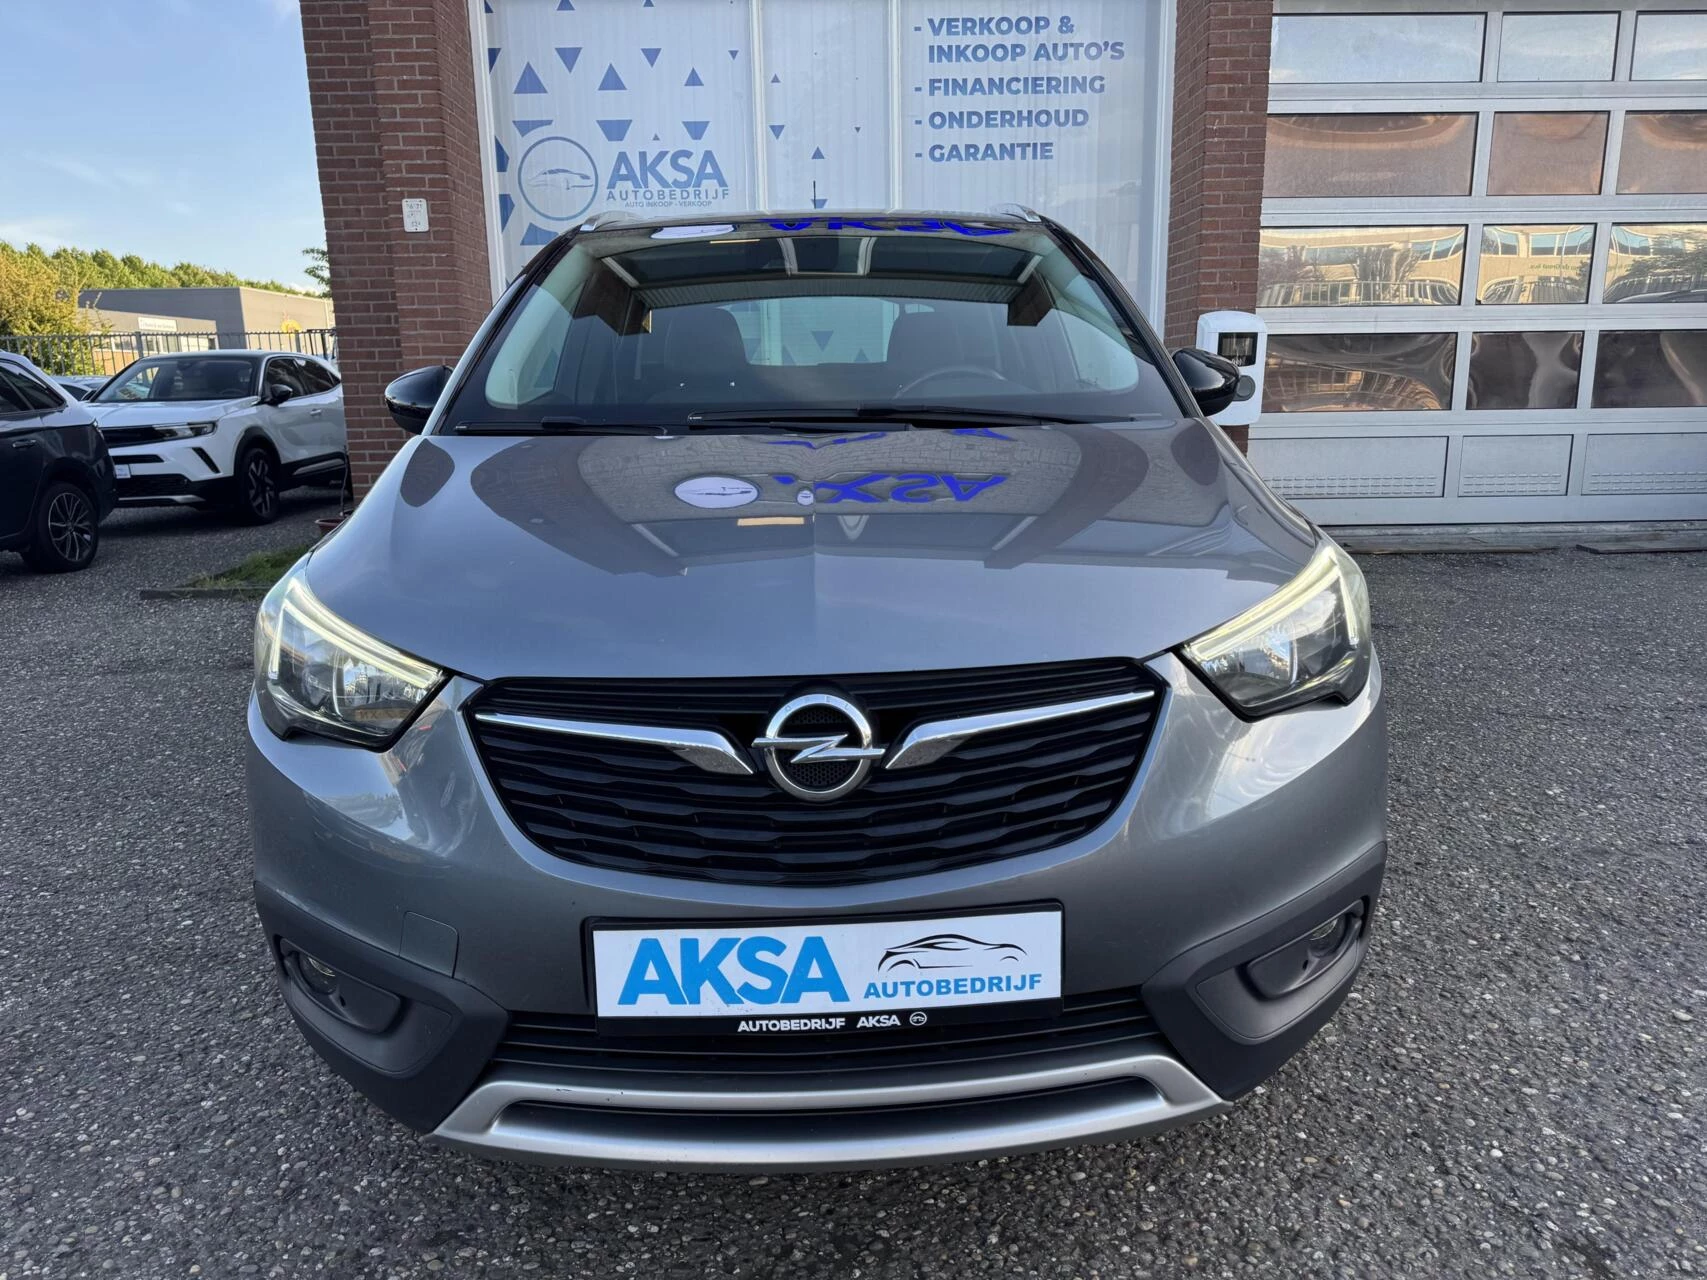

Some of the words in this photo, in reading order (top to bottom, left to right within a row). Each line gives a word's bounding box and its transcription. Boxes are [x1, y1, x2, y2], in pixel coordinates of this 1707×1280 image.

[927, 16, 1050, 36] VERKOOP
[1058, 15, 1075, 34] &
[928, 43, 1026, 63] INKOOP
[1033, 41, 1125, 61] AUTO'S
[928, 75, 1105, 96] FINANCIERING
[928, 109, 1089, 129] ONDERHOUD
[928, 142, 1054, 162] GARANTIE
[606, 149, 728, 189] AKSA
[606, 189, 729, 201] AUTOBEDRIJF
[679, 200, 713, 208] VERKOOP
[617, 936, 850, 1005] AKSA
[863, 973, 1042, 999] AUTOBEDRIJF
[737, 1018, 846, 1032] AUTOBEDRIJF
[856, 1015, 901, 1028] AKSA
